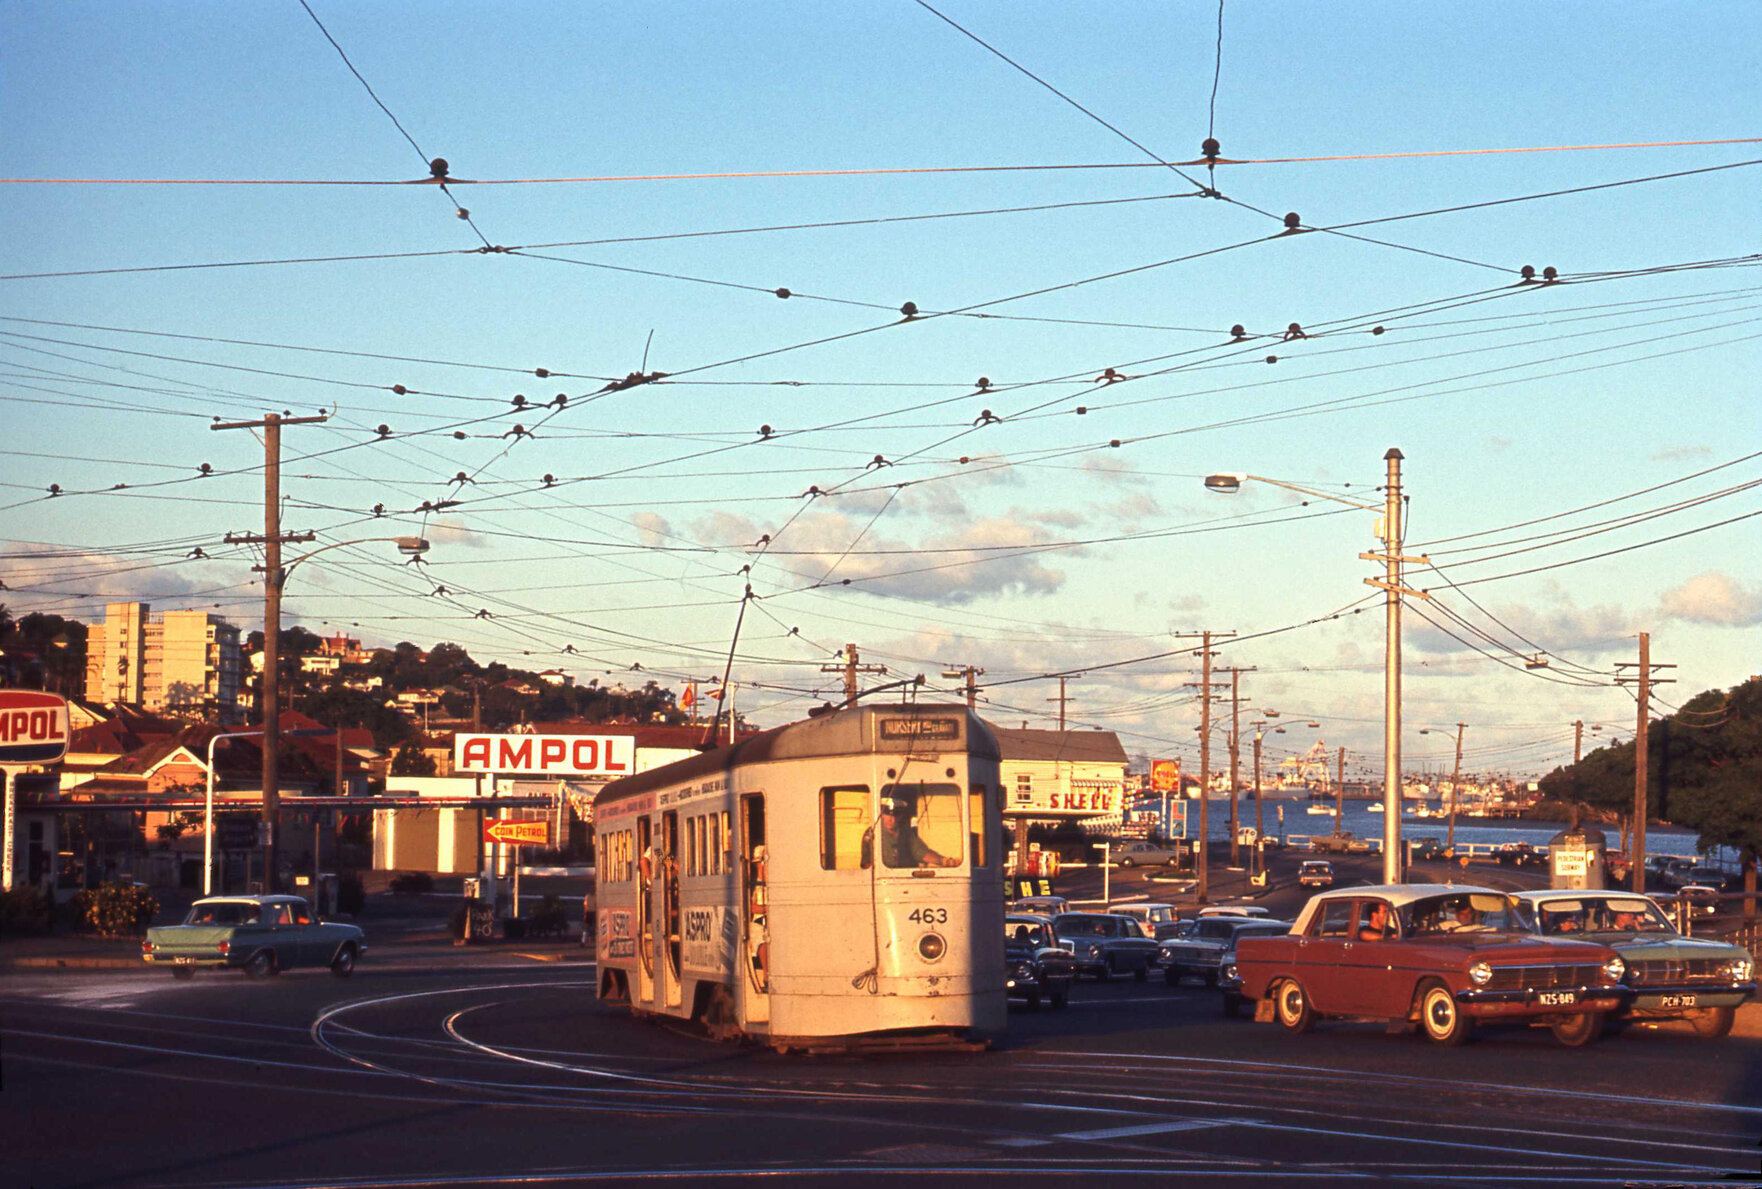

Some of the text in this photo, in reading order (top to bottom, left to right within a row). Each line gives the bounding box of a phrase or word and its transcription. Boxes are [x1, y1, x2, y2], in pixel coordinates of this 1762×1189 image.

[463, 738, 626, 771] AMPOL
[1050, 793, 1110, 810] SHELL
[908, 908, 948, 924] 463
